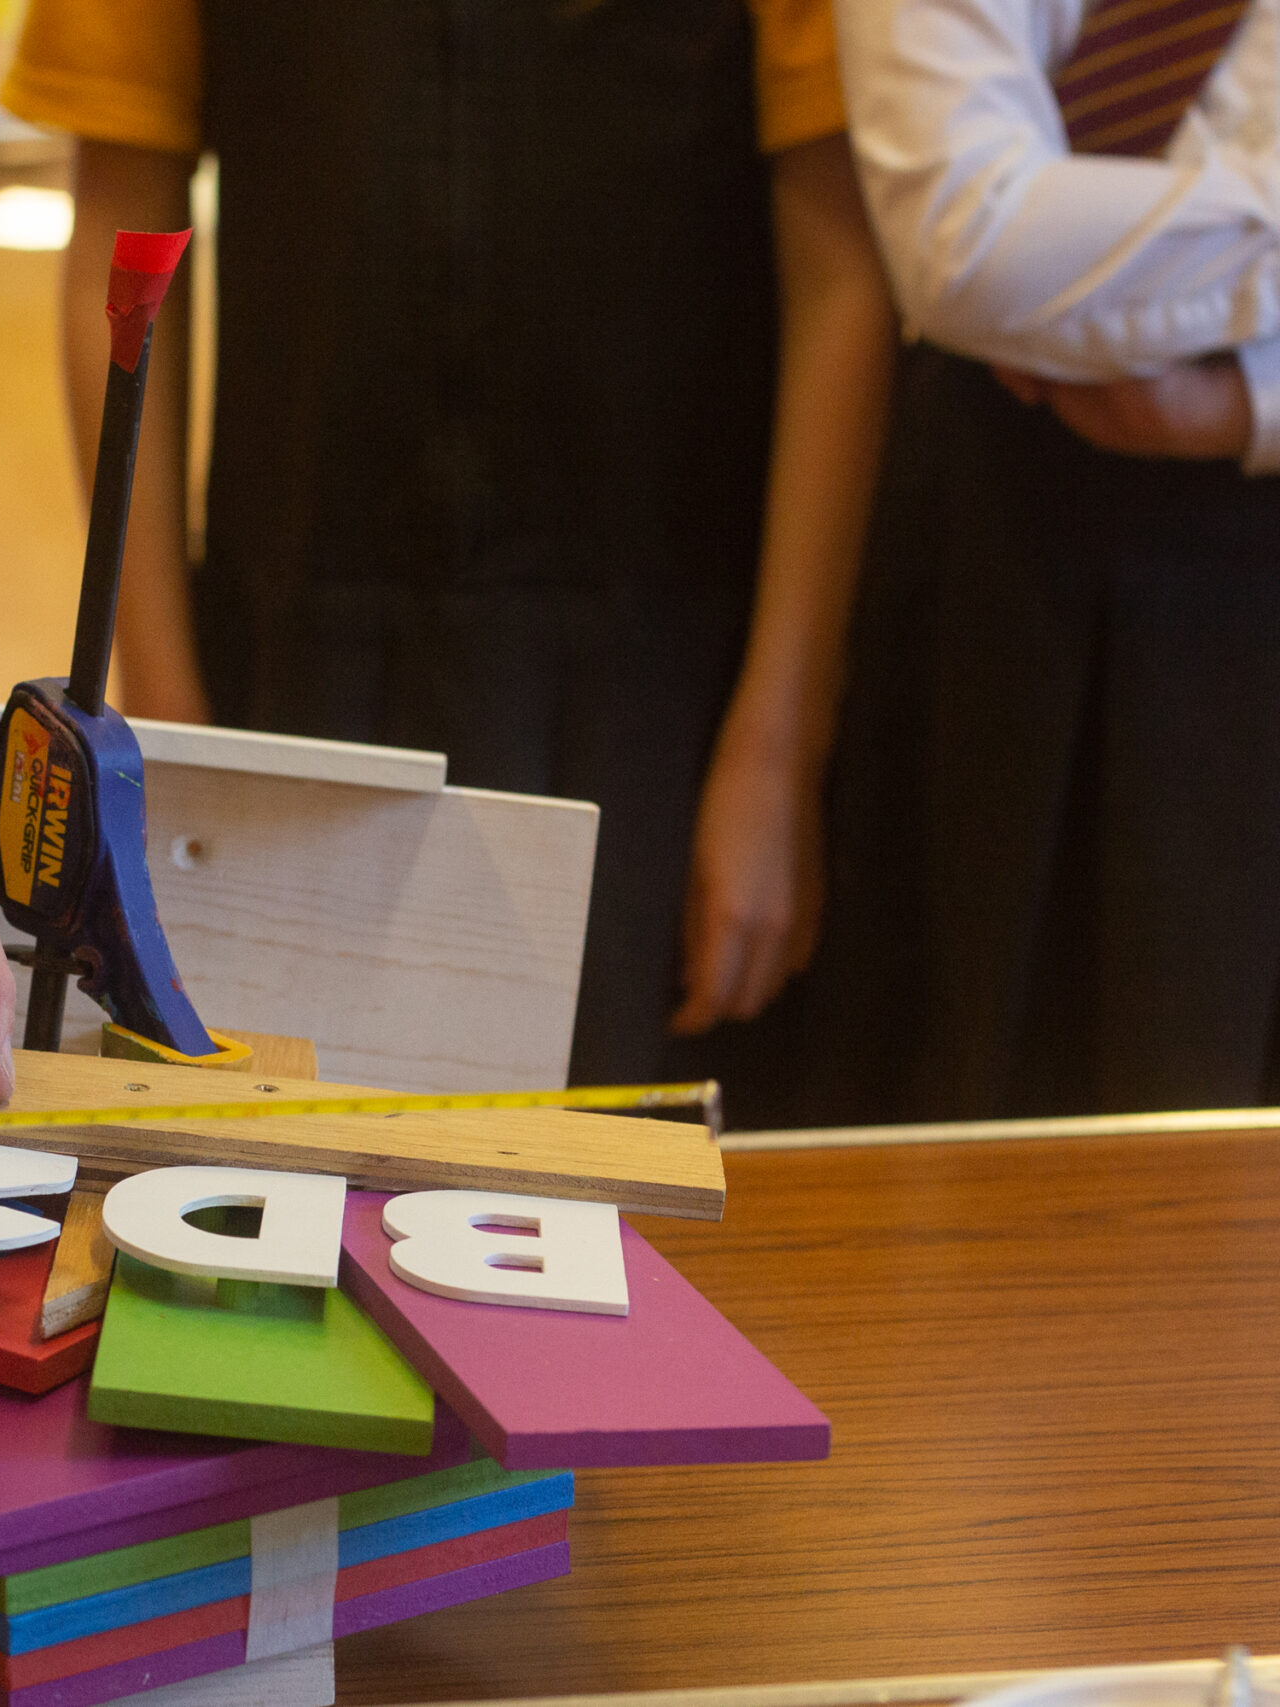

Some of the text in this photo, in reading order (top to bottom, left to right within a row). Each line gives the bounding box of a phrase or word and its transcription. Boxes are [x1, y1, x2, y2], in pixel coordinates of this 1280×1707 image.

[22, 758, 43, 873] QUICK-GRIP
[38, 764, 72, 888] IRWIN
[102, 1166, 347, 1288] D
[382, 1189, 629, 1317] B
